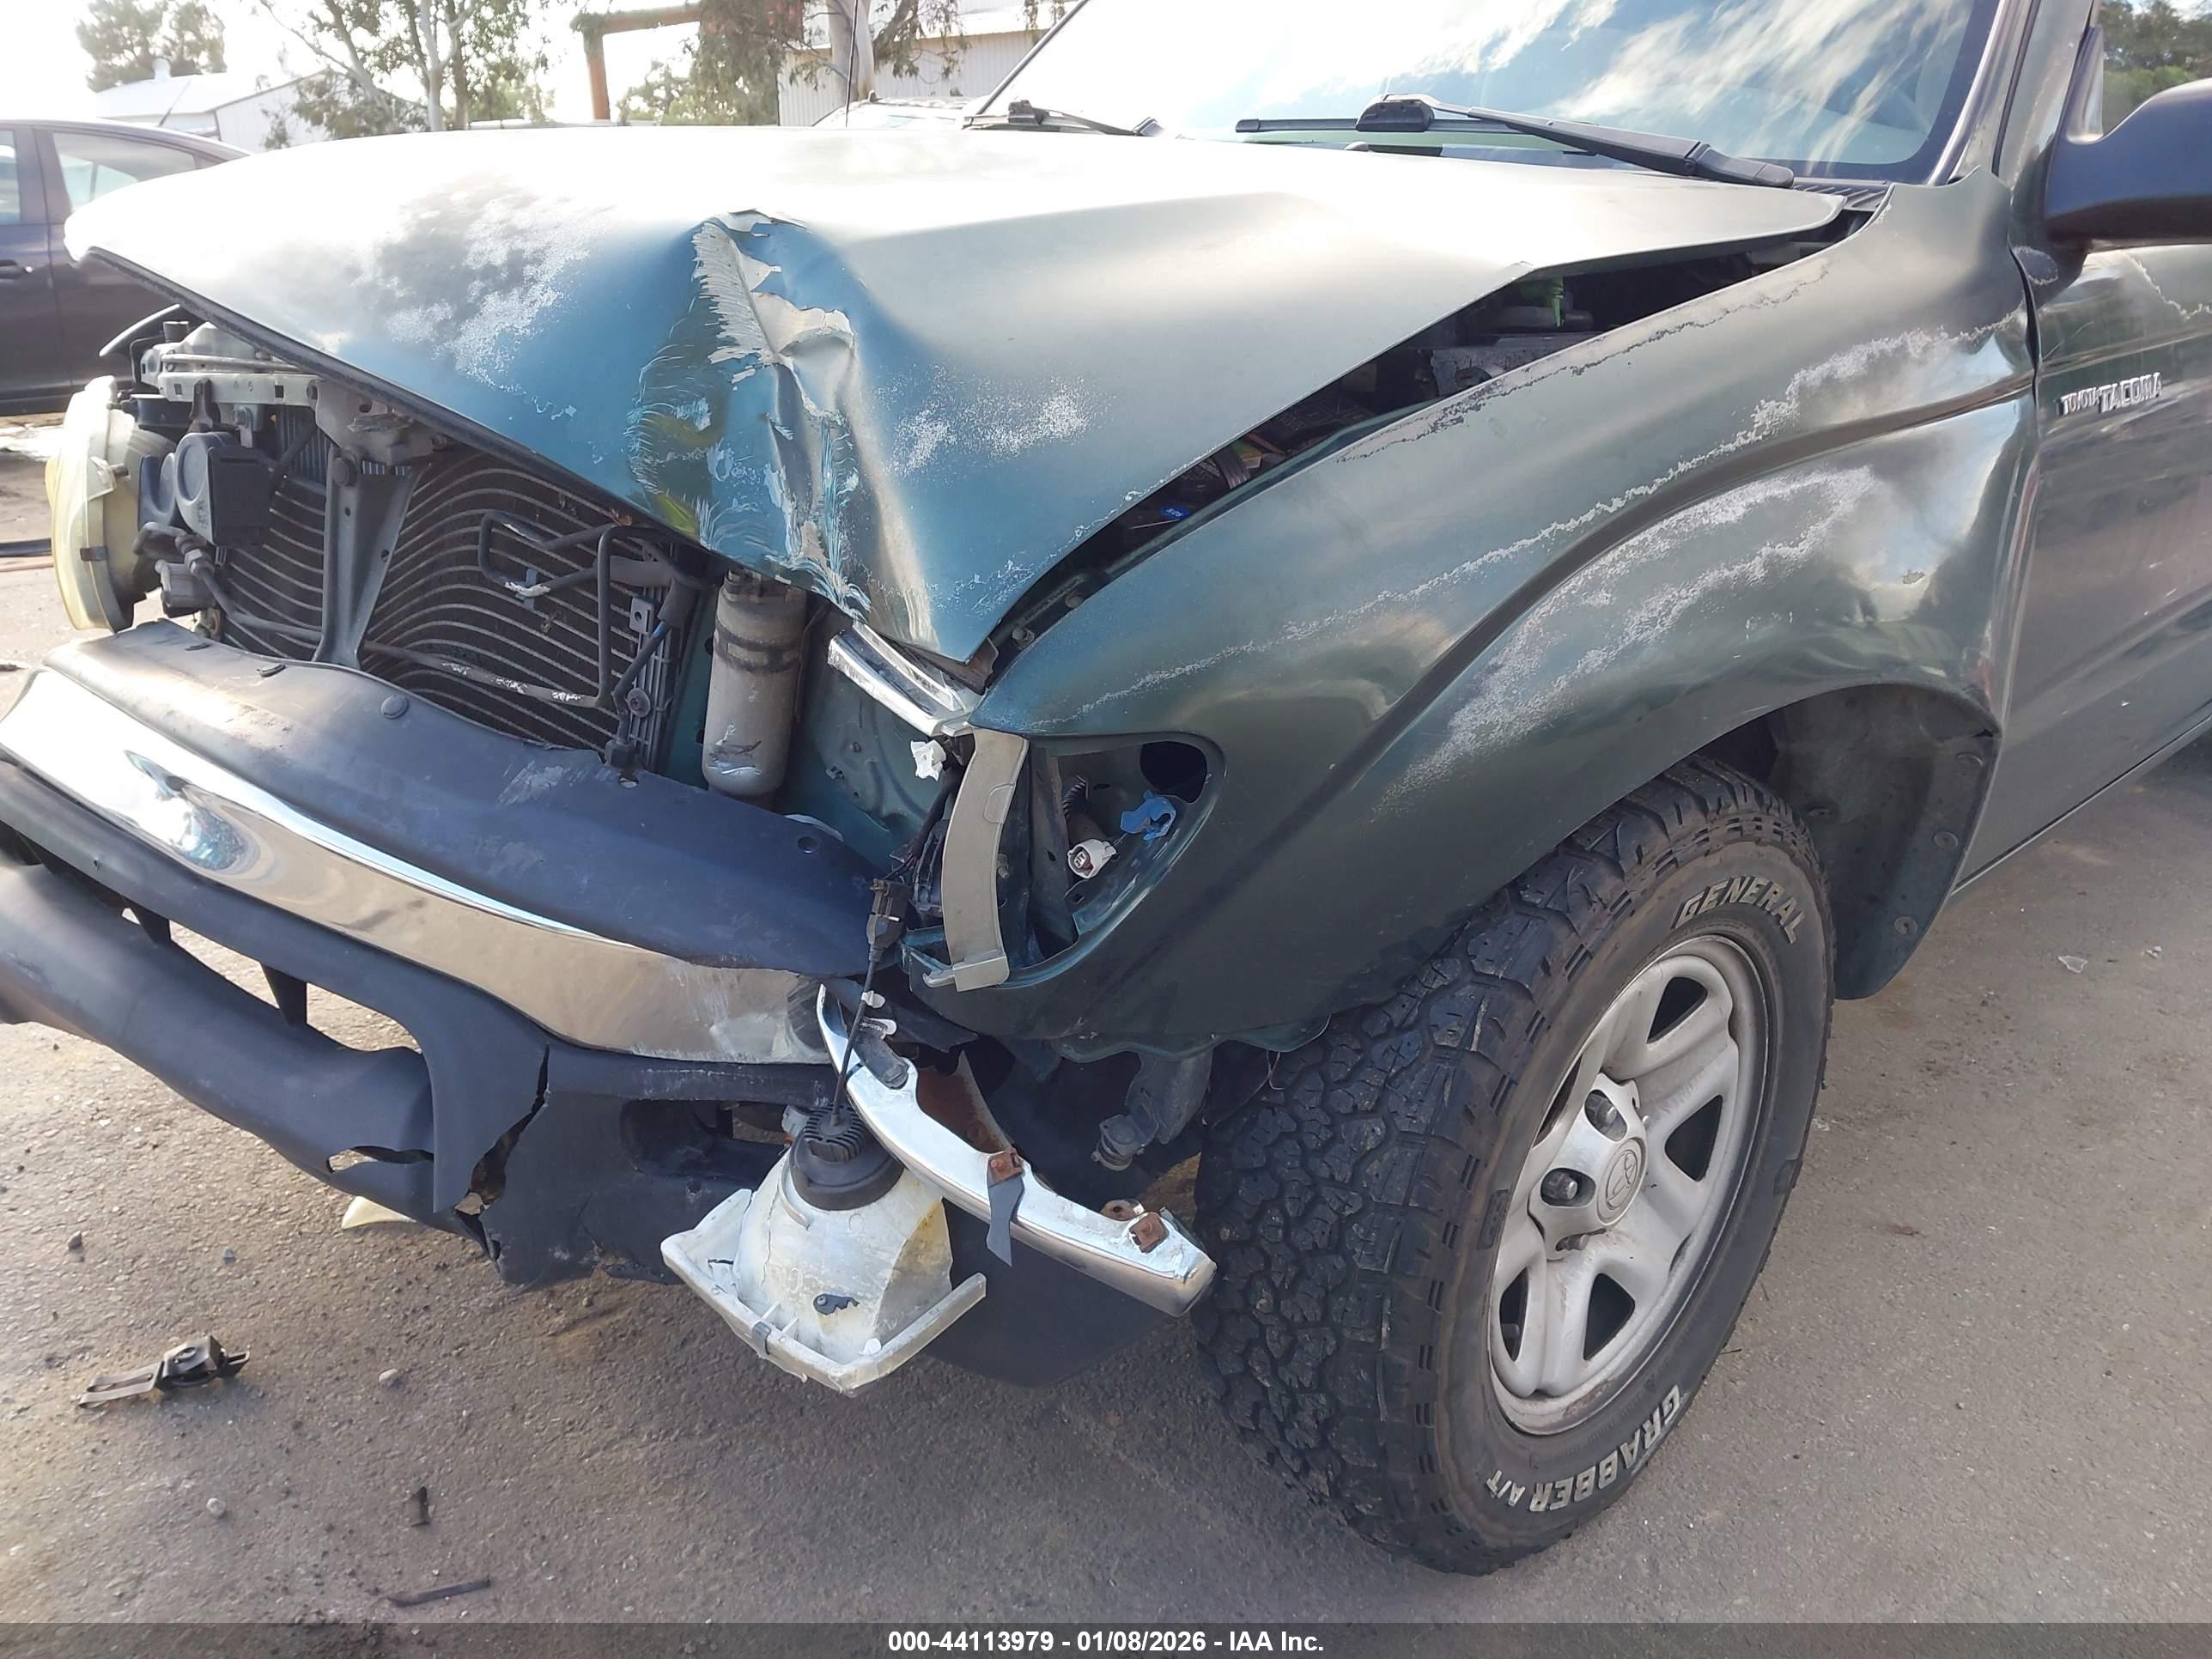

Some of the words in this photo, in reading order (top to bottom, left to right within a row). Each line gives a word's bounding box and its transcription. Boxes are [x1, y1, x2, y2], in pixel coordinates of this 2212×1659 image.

[2099, 372, 2162, 414] TACOMA
[1674, 875, 1806, 945] GENERAL
[1528, 1383, 1681, 1512] GRABBER
[1486, 1469, 1526, 1507] A/T
